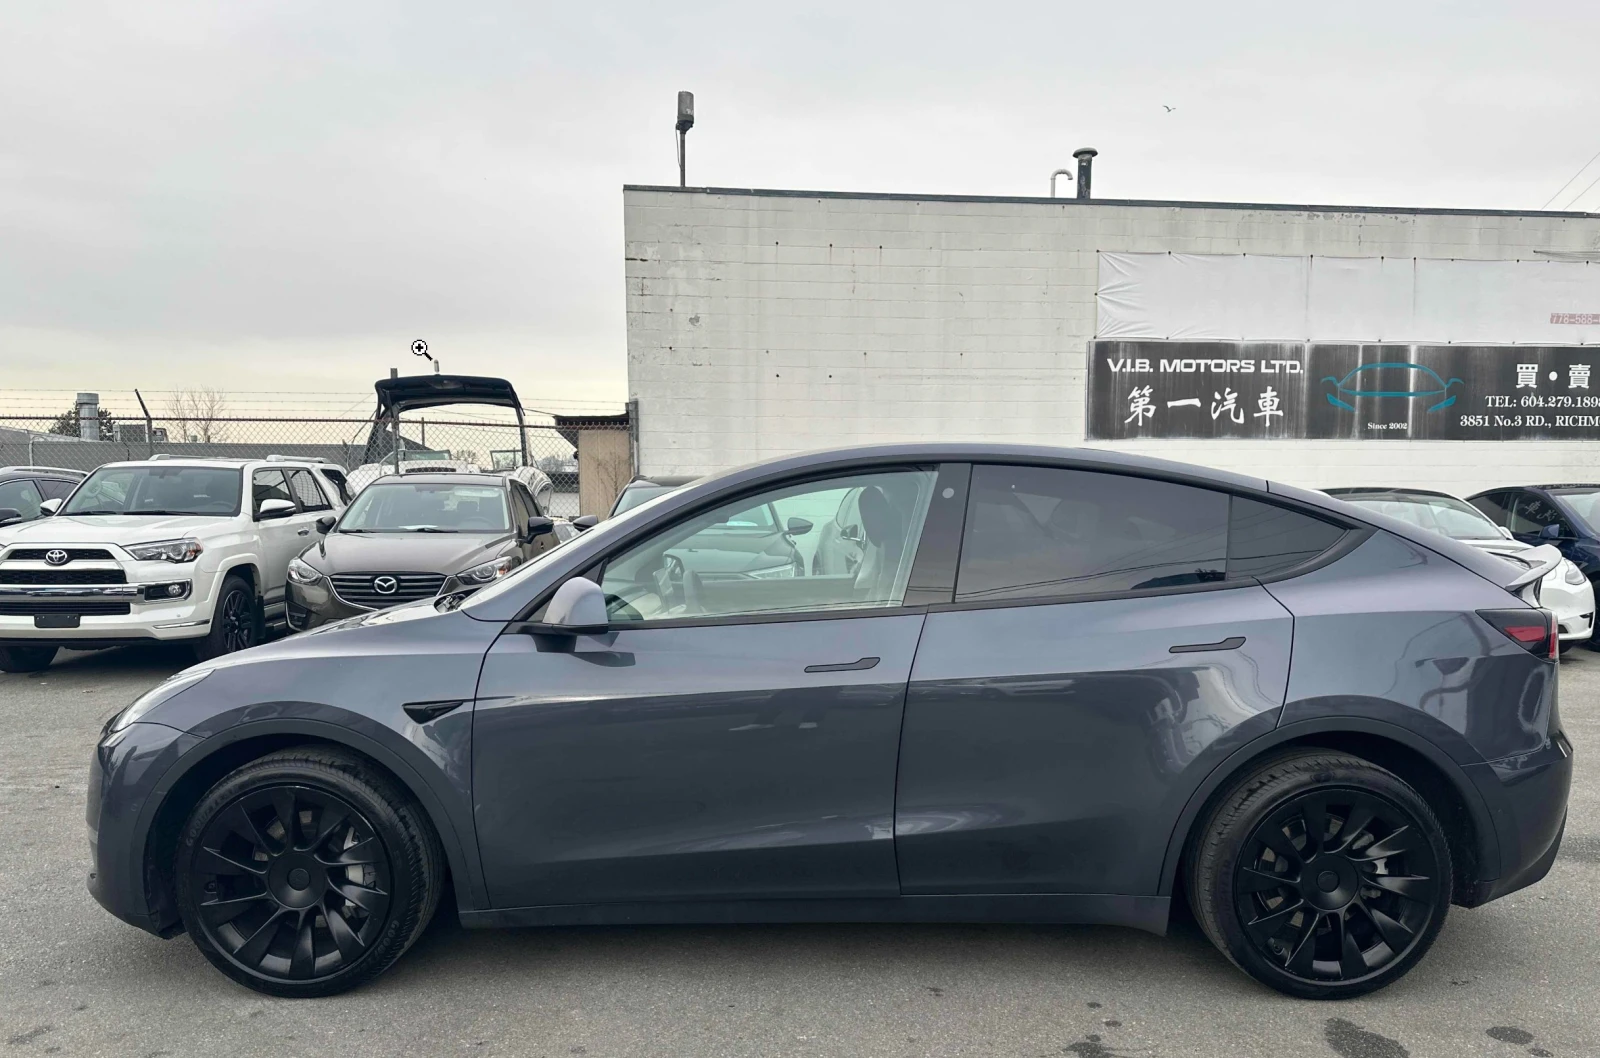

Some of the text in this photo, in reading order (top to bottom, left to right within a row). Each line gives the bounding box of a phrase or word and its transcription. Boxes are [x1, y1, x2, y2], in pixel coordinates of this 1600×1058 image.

[1550, 313, 1600, 324] 778-588-
[1106, 358, 1304, 374] V.I.B. MOTORS LTD.
[1124, 385, 1284, 427] 第一汽車
[1485, 395, 1600, 408] TEL: 604.279.189
[1367, 422, 1408, 430] Since 2002
[1460, 415, 1600, 429] 3851 No.3 RD., RICHM
